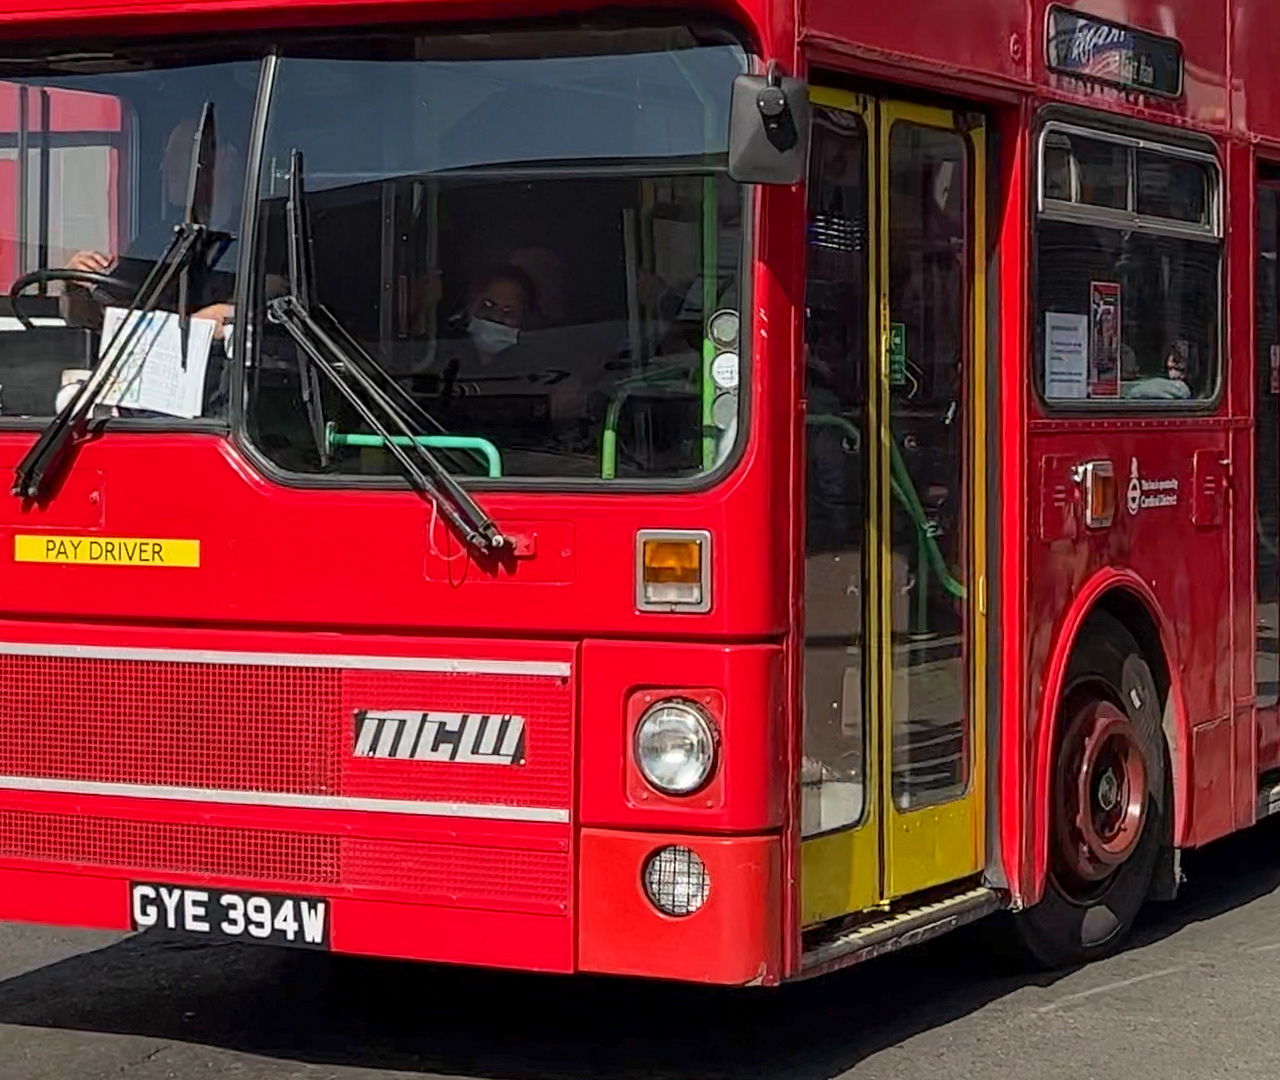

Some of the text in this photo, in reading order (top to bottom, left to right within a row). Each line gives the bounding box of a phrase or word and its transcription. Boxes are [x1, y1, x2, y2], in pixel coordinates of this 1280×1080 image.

[46, 540, 164, 562] PAY DRIVER
[132, 884, 326, 944] GYE 394W
